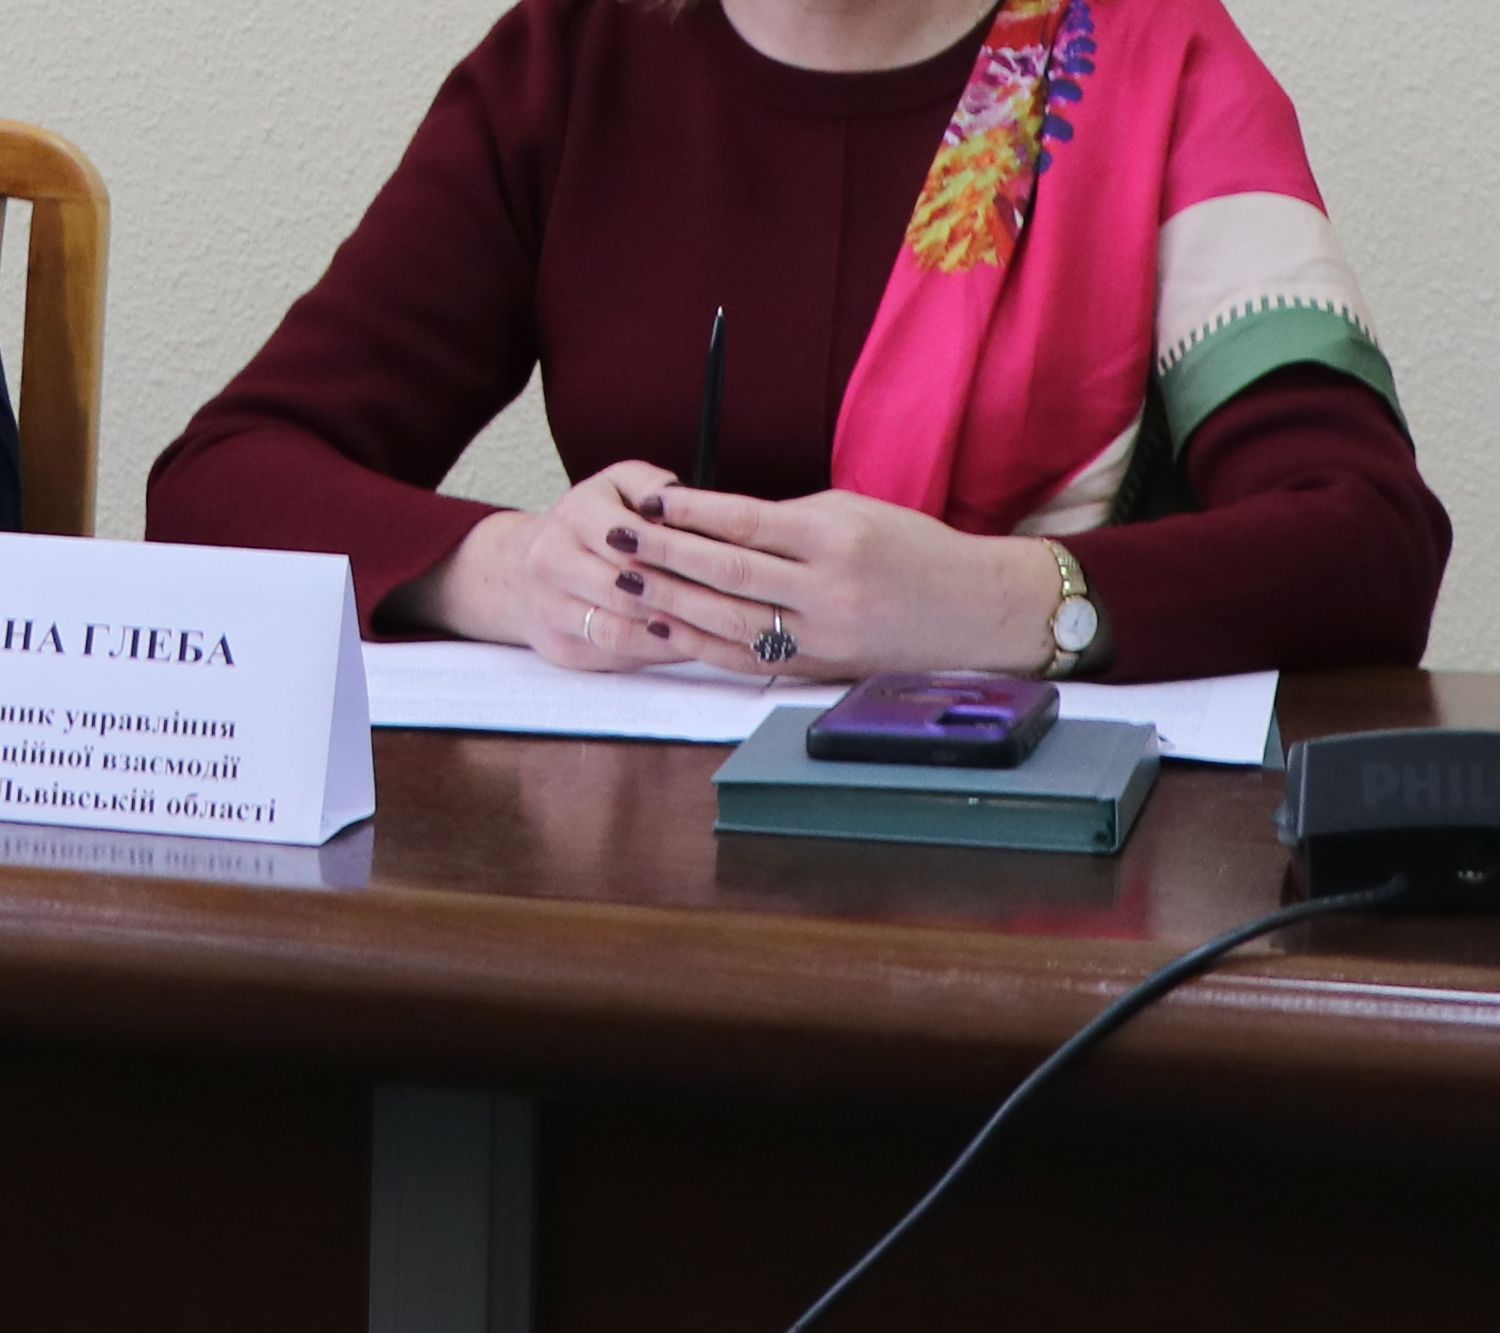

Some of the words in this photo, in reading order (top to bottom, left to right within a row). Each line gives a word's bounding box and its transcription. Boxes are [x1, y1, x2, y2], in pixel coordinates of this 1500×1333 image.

[82, 623, 236, 667] ГЛЕБА
[62, 709, 236, 740] управління
[165, 791, 276, 825] області
